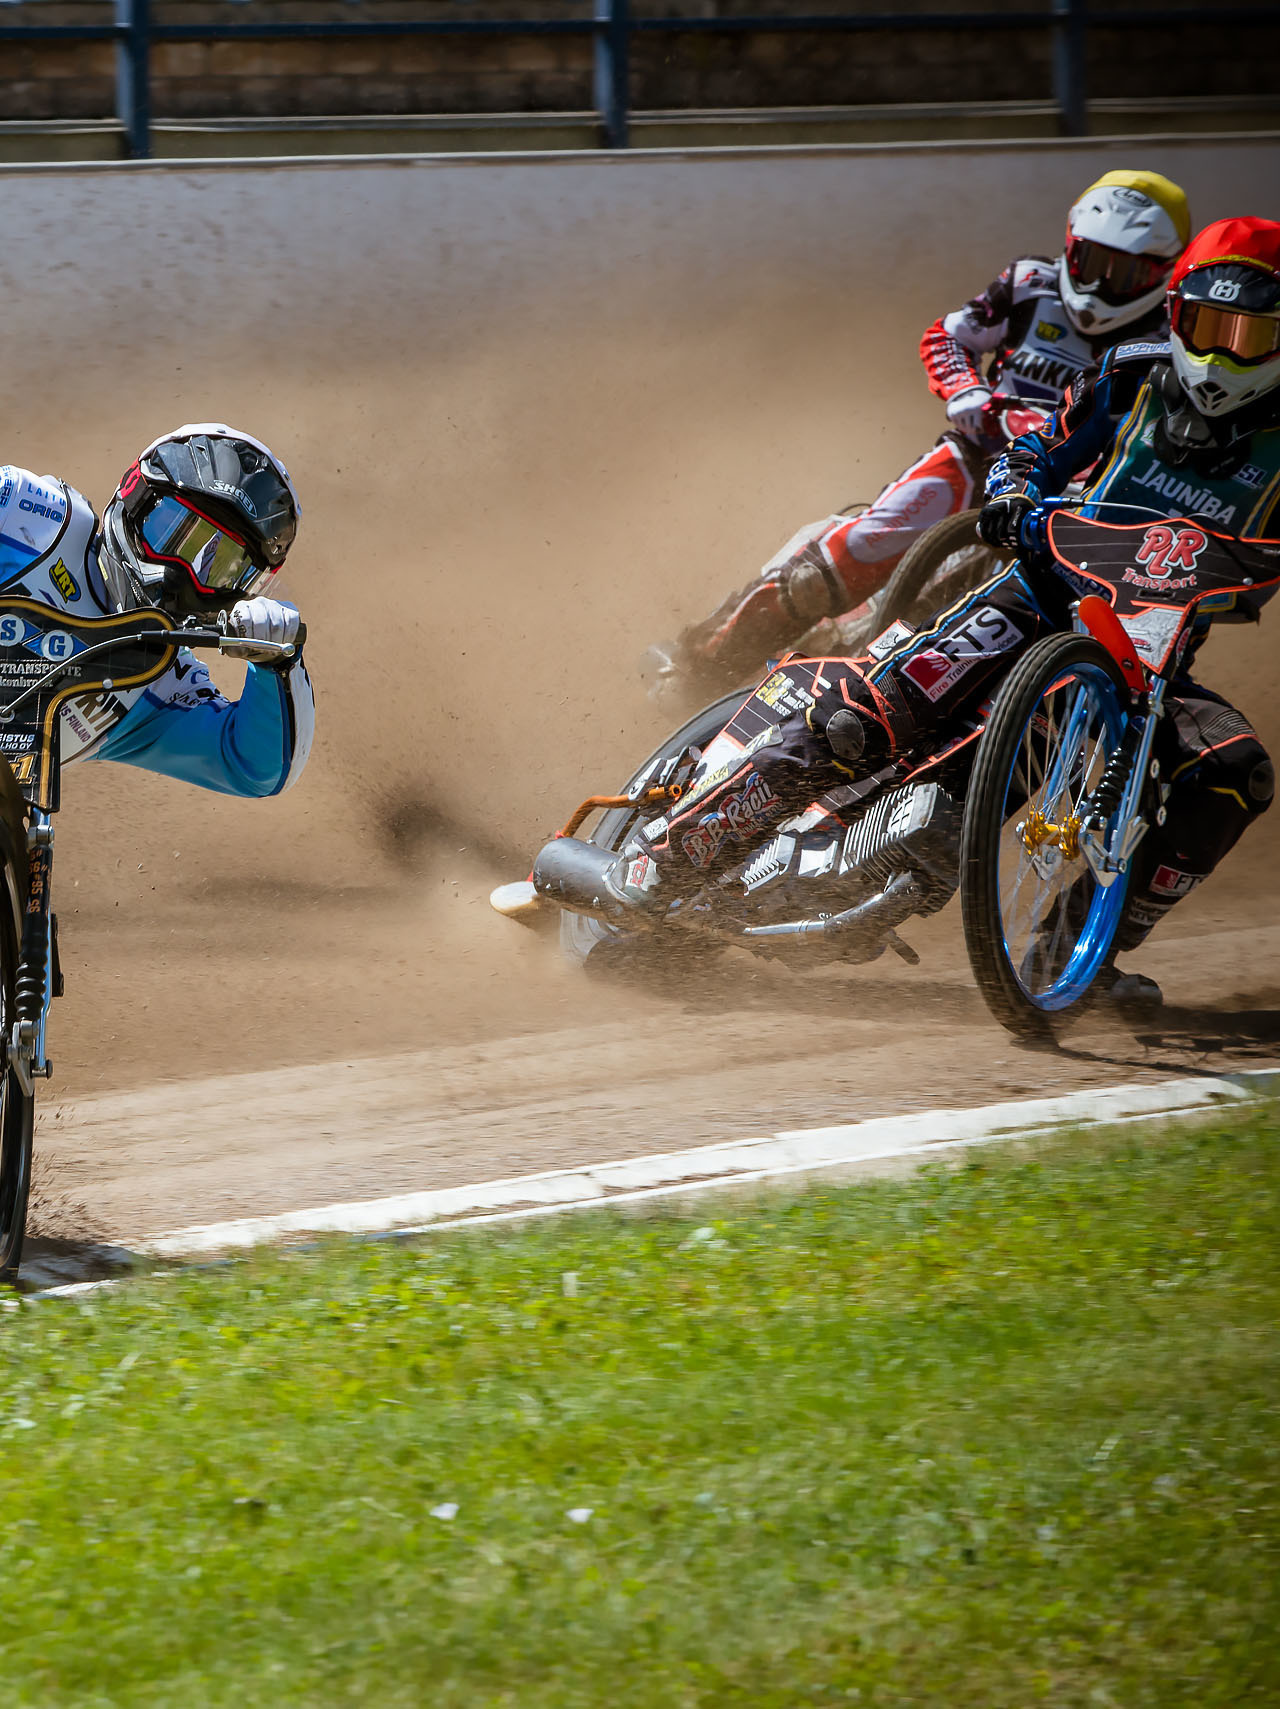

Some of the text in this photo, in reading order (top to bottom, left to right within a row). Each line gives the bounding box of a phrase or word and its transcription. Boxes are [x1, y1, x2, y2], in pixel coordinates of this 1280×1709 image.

[213, 479, 256, 513] SHOEI
[1131, 459, 1238, 525] JAUNĪBA
[1135, 526, 1208, 579] PLR
[52, 557, 77, 604] VRT
[1122, 567, 1198, 591] Transport
[933, 609, 1009, 664] FTS
[929, 680, 950, 700] Fire
[65, 711, 92, 743] FINLAND
[19, 742, 33, 751] OY
